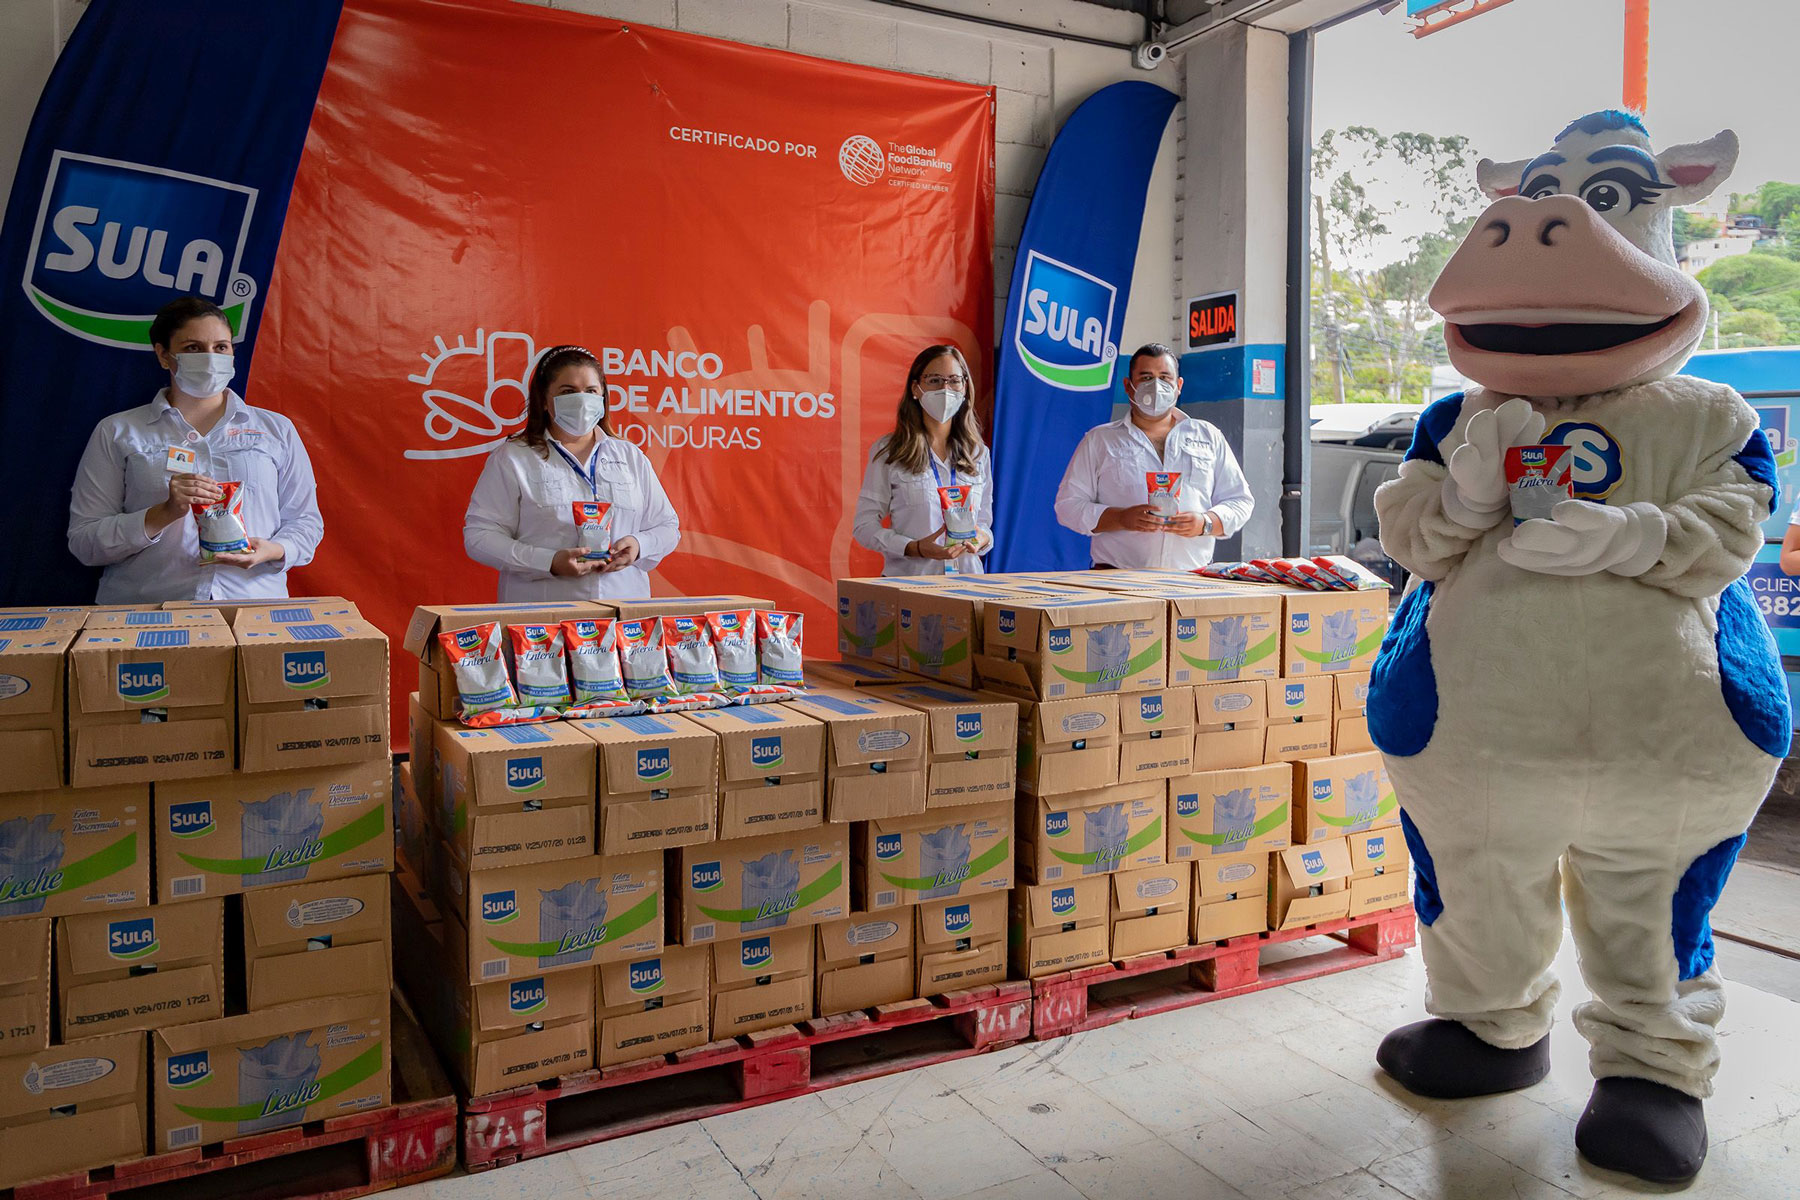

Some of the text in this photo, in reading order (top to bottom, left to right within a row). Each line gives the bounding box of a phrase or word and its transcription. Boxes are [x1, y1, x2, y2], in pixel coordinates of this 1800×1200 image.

[669, 126, 817, 159] CERTIFICADO POR
[888, 153, 952, 172] FoodBanking
[888, 163, 926, 176] Network
[888, 179, 949, 192] CERTIFIED MEMBER
[44, 205, 224, 297] SULA
[1024, 288, 1102, 357] SULA
[1190, 304, 1236, 338] SALIDA
[603, 347, 723, 380] BANCO
[608, 385, 836, 419] DE ALIMENTOS
[1522, 451, 1543, 460] SULA
[1563, 428, 1609, 484] S
[1518, 477, 1554, 489] Entera
[578, 624, 597, 633] SULA
[1000, 616, 1016, 628] SULA
[1292, 618, 1309, 629] SULA
[526, 627, 546, 636] SULA
[624, 627, 642, 635] SULA
[1177, 624, 1196, 635] SULA
[458, 634, 478, 645] SULA
[1050, 635, 1071, 647] SULA
[524, 650, 555, 661] Entera
[578, 645, 607, 655] Entera
[461, 656, 491, 667] Entera
[1218, 652, 1248, 671] Leche
[286, 661, 325, 677] SULA
[1098, 659, 1131, 683] Leche
[121, 673, 163, 689] SULA
[1286, 690, 1304, 700] SULA
[1142, 702, 1162, 713] SULA
[957, 720, 982, 733] SULA
[754, 744, 781, 759] SULA
[639, 756, 669, 771] SULA
[509, 766, 542, 781] SULA
[1313, 786, 1331, 796] SULA
[1178, 800, 1198, 811] SULA
[172, 812, 209, 828] SULA
[1047, 819, 1067, 831] SULA
[263, 836, 324, 872] Leche
[877, 841, 901, 853] SULA
[1095, 840, 1129, 864] Leche
[1368, 844, 1384, 854] SULA
[1305, 858, 1323, 869] SULA
[693, 870, 720, 884] SULA
[932, 863, 971, 888] Leche
[0, 867, 64, 901] Leche
[484, 900, 514, 915] SULA
[756, 890, 800, 920] Leche
[1053, 896, 1074, 907] SULA
[946, 913, 970, 926] SULA
[112, 929, 152, 947] SULA
[557, 922, 607, 955] Leche
[743, 946, 769, 960] SULA
[631, 968, 661, 983] SULA
[512, 988, 543, 1004] SULA
[10, 1025, 36, 1037] 17:17
[170, 1061, 207, 1079] SULA
[260, 1081, 321, 1118] Leche
